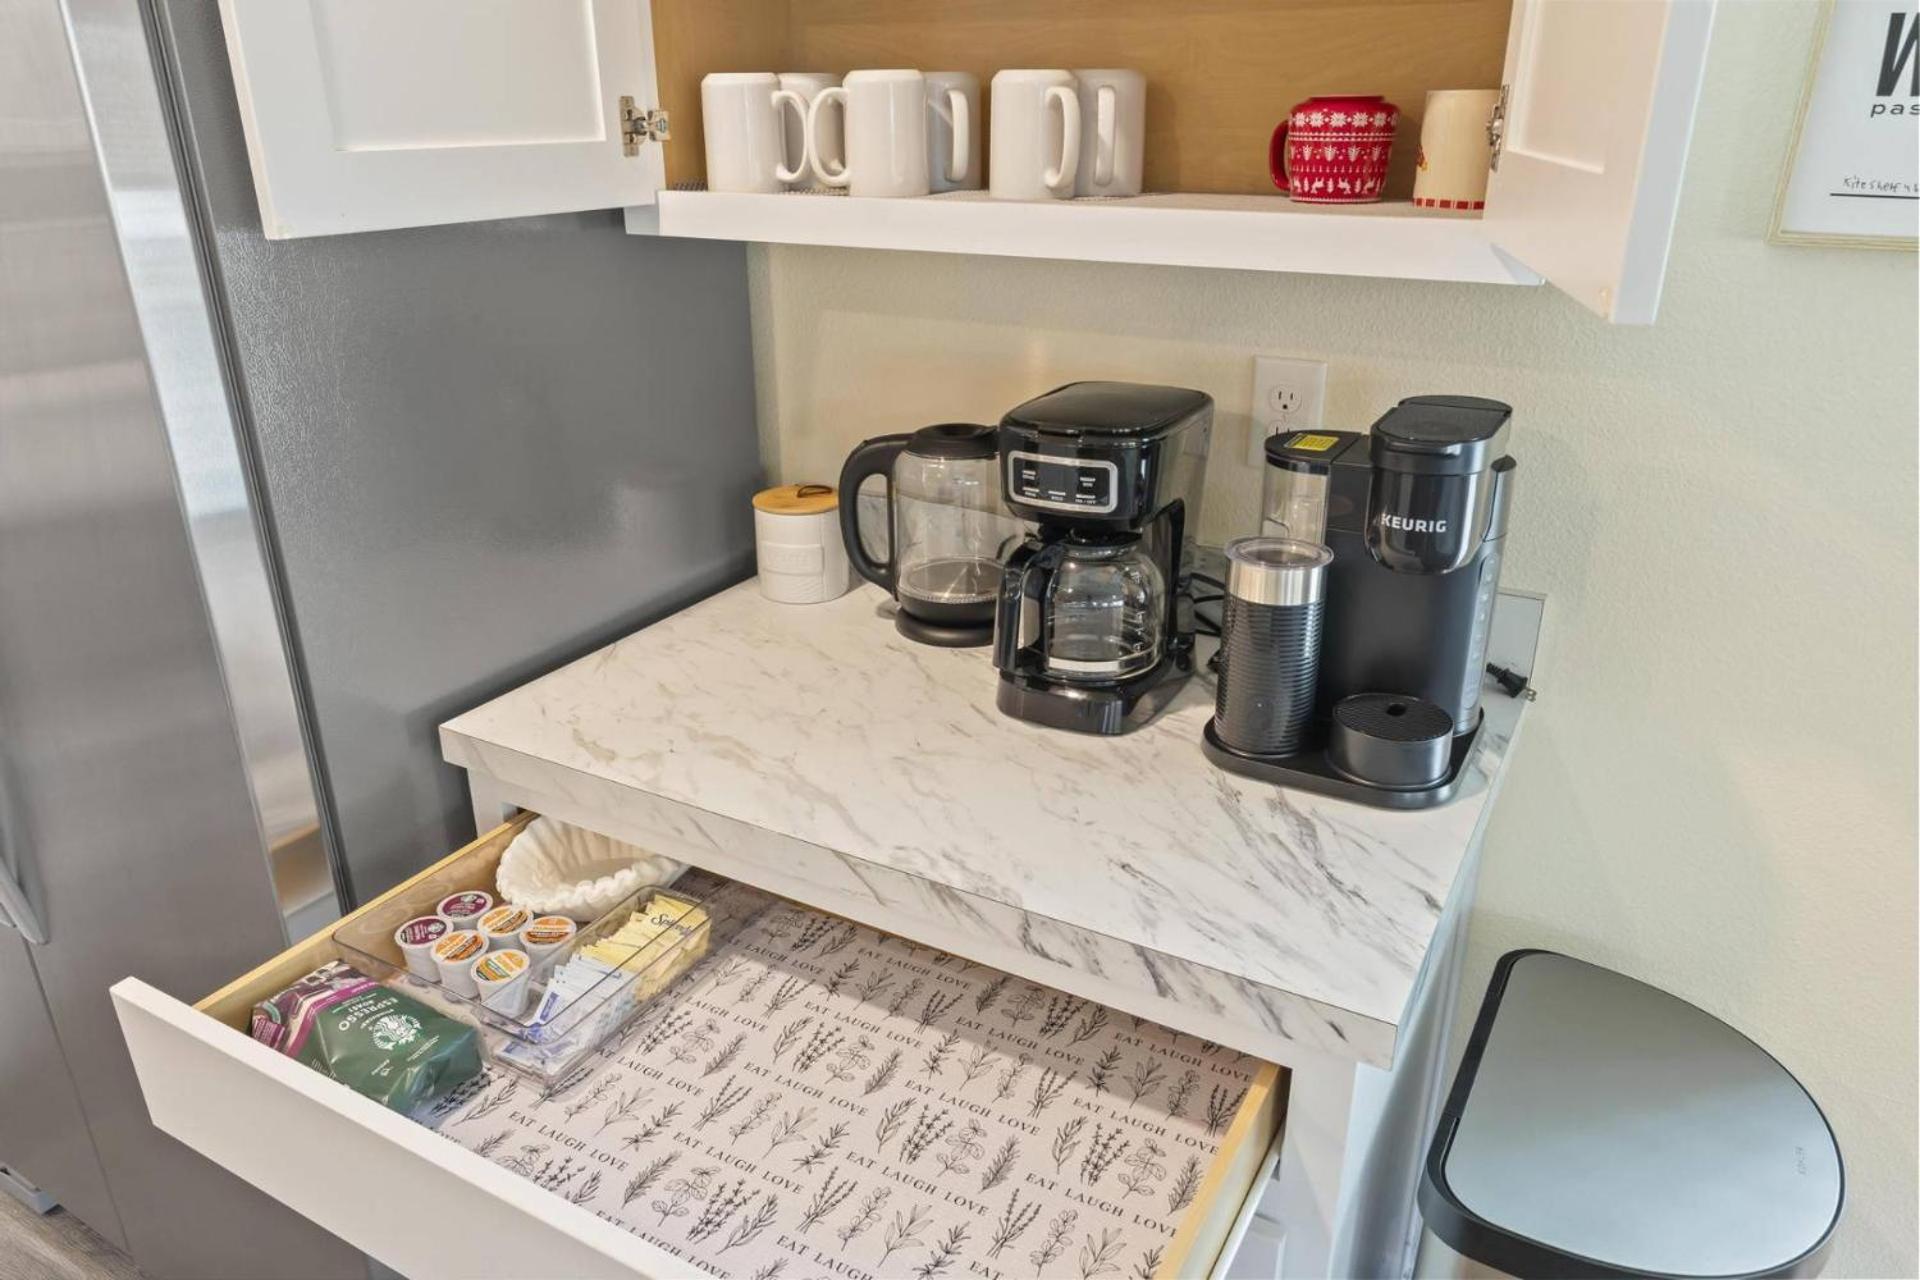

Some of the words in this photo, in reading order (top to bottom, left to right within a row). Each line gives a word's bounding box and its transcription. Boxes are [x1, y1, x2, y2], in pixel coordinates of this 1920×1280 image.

[1381, 513, 1447, 533] KEURIG
[936, 973, 971, 991] LOVE
[733, 1014, 768, 1033] LOVE
[804, 1001, 831, 1015] EAT
[834, 1011, 881, 1034] LAUGH
[886, 1030, 922, 1048] LOVE
[955, 1016, 984, 1030] EAT
[988, 1027, 1038, 1050] LAUGH
[1045, 1046, 1085, 1067] LOVE
[1115, 1032, 1144, 1047] EAT
[1150, 1043, 1202, 1067] LAUGH
[617, 1056, 664, 1081] LAUGH
[667, 1077, 704, 1097] LOVE
[743, 1062, 771, 1077] EAT
[774, 1074, 824, 1099] LAUGH
[829, 1096, 869, 1116] LOVE
[904, 1079, 934, 1095] EAT
[939, 1092, 992, 1117] LAUGH
[998, 1114, 1041, 1136] LOVE
[1072, 1097, 1104, 1114] EAT
[1110, 1111, 1167, 1137] LAUGH
[1175, 1134, 1221, 1156] LOVE
[508, 1111, 537, 1128] EAT
[537, 1124, 588, 1152] LAUGH
[589, 1148, 631, 1173] LOVE
[672, 1131, 703, 1149] EAT
[705, 1145, 758, 1174] LAUGH
[762, 1170, 805, 1195] LOVE
[846, 1151, 878, 1170] EAT
[881, 1166, 938, 1196] LAUGH
[944, 1191, 990, 1218] LOVE
[1025, 1173, 1059, 1192] EAT
[1064, 1188, 1124, 1218] LAUGH
[776, 1234, 810, 1256] EAT
[813, 1252, 875, 1280] LAUGH
